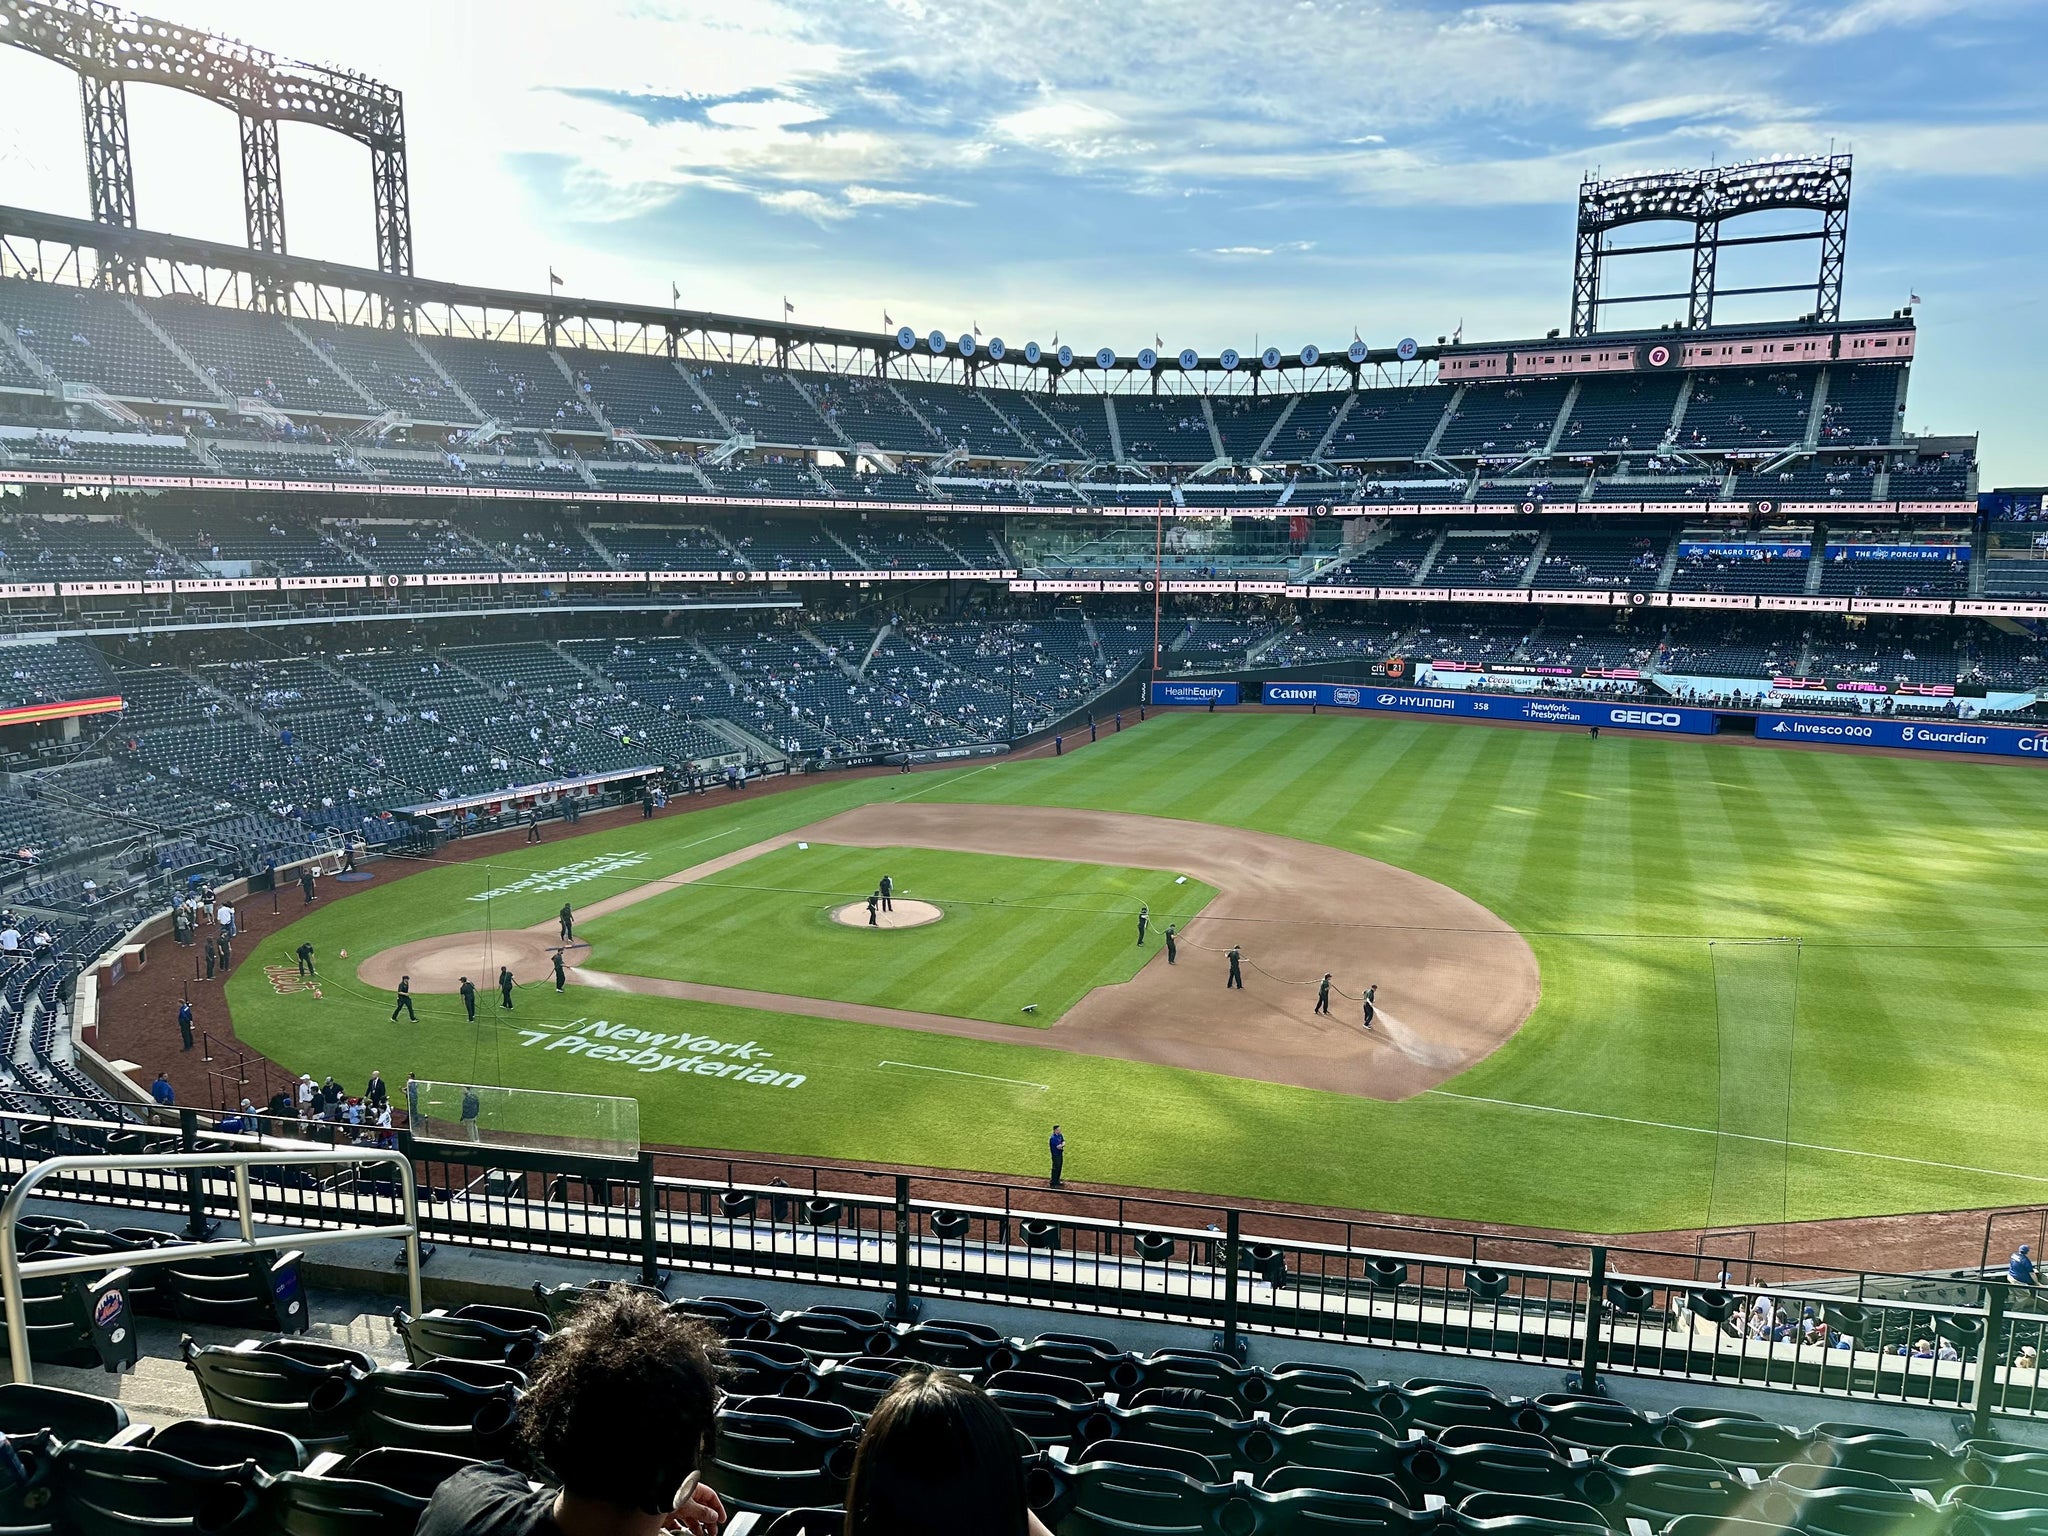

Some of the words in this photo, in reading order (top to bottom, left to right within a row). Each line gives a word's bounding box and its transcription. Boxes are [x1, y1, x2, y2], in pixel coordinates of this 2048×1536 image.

[903, 333, 910, 344] 5
[932, 336, 942, 347] 18
[962, 340, 972, 351] 16
[991, 343, 1002, 354] 24
[1400, 343, 1413, 354] 42
[1028, 347, 1037, 357] 17
[1060, 351, 1070, 361] 36
[1350, 347, 1366, 357] SHEA
[1101, 353, 1110, 363] 31
[1142, 354, 1151, 364] 41
[1184, 354, 1193, 364] 14
[1224, 354, 1236, 364] 37
[1890, 551, 1919, 559] PORCH
[1921, 551, 1939, 559] BAR
[1371, 664, 1385, 673] citi
[1392, 664, 1401, 672] 21
[1491, 665, 1525, 673] WELCOME
[1510, 678, 1532, 686] LIGHT
[1836, 683, 1857, 691] CITI
[1857, 684, 1887, 692] FIELD
[1165, 687, 1223, 699] HealthEquity
[1269, 688, 1317, 699] Canon
[1400, 696, 1454, 709] HYUNDAI
[1473, 702, 1489, 711] 358
[1530, 711, 1580, 721] Presbyterian
[1610, 709, 1681, 727] GEICO
[1794, 722, 1843, 735] Invesco
[1844, 726, 1873, 737] QQQ
[1917, 729, 1987, 745] Guardian
[853, 757, 873, 765] DELTA
[577, 1020, 774, 1060] NewYork-
[544, 1035, 807, 1089] Presbyterian
